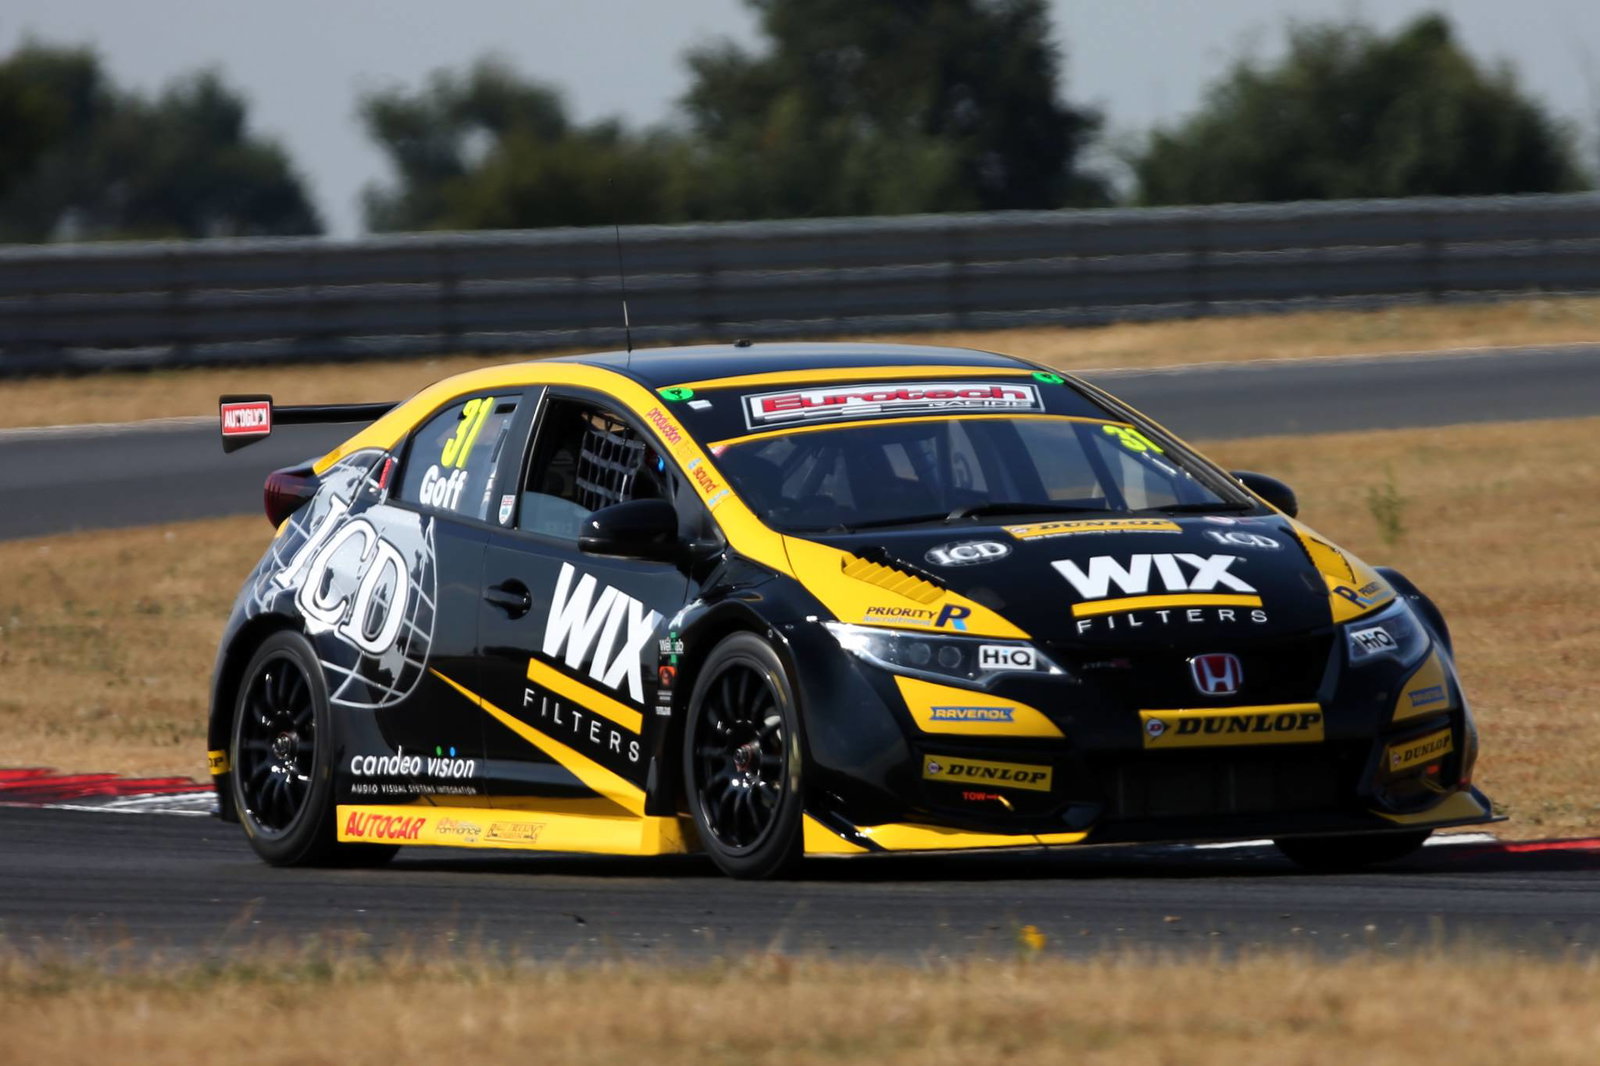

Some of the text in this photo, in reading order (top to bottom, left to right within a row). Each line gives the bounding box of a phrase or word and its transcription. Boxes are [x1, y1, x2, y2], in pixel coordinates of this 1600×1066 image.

[761, 386, 1028, 413] Eurotech
[441, 397, 494, 468] 31
[646, 407, 682, 445] production
[1102, 424, 1165, 453] 31
[419, 464, 468, 510] Goff
[692, 465, 717, 494] sound
[930, 541, 1008, 565] ICD
[274, 494, 410, 654] ICD
[1050, 553, 1258, 599] WIX
[866, 606, 938, 619] PRIORITY
[1076, 608, 1268, 634] FILTERS
[542, 561, 664, 704] WIX
[982, 648, 1031, 667] HiQ
[523, 688, 641, 763] FILTERS
[935, 709, 1011, 719] RAVENOL
[1174, 713, 1322, 735] DUNLOP
[350, 745, 475, 778] candeo vision
[1403, 737, 1451, 762] DUNLOP
[944, 763, 1048, 784] DUNLOP
[351, 783, 379, 794] AUDIO
[381, 784, 408, 794] VISUAL
[962, 791, 986, 800] TOW
[344, 811, 427, 839] AUTOCAR
